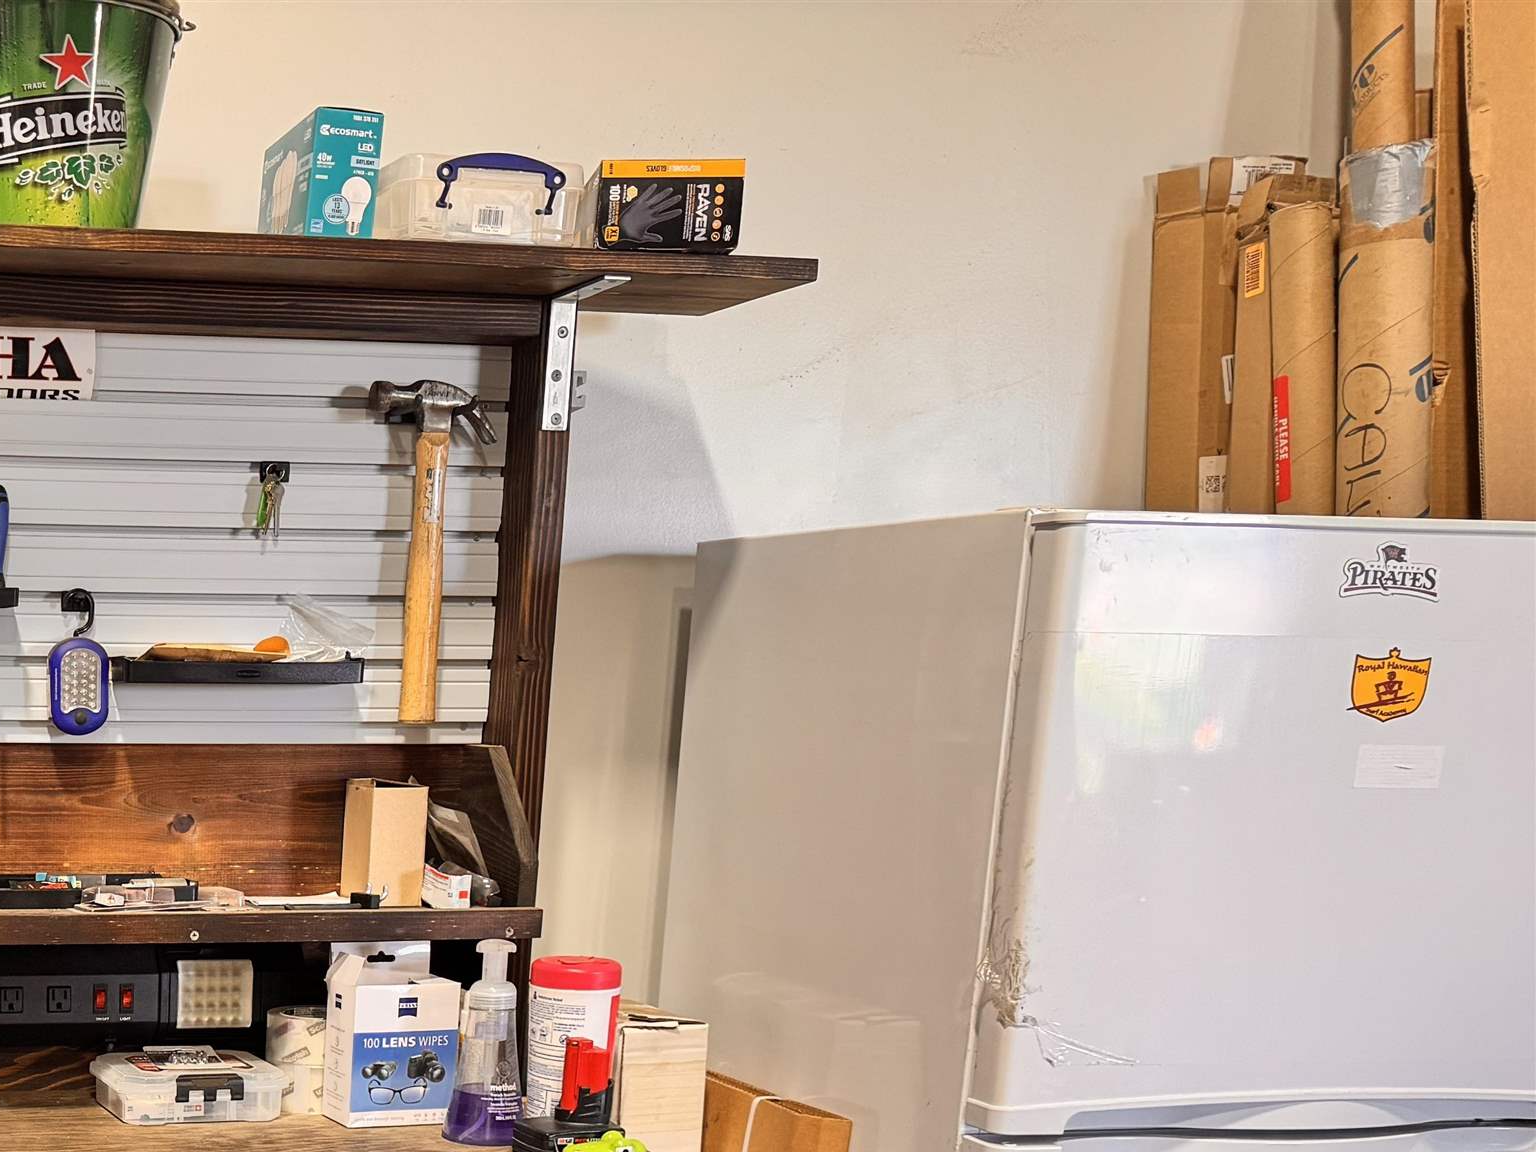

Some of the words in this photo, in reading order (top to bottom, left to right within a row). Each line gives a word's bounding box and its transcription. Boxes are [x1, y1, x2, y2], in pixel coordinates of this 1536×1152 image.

[22, 81, 47, 91] TRADE
[329, 127, 374, 138] ecosmart
[357, 142, 374, 152] LED
[609, 184, 621, 201] 100
[693, 183, 711, 242] RAVEN
[1278, 417, 1289, 461] PLEASE
[1347, 561, 1437, 590] PIRATES
[1356, 661, 1385, 673] Royal
[363, 1038, 380, 1048] 100
[382, 1036, 416, 1048] LENS
[418, 1035, 449, 1047] WIPES
[490, 1081, 517, 1091] method
